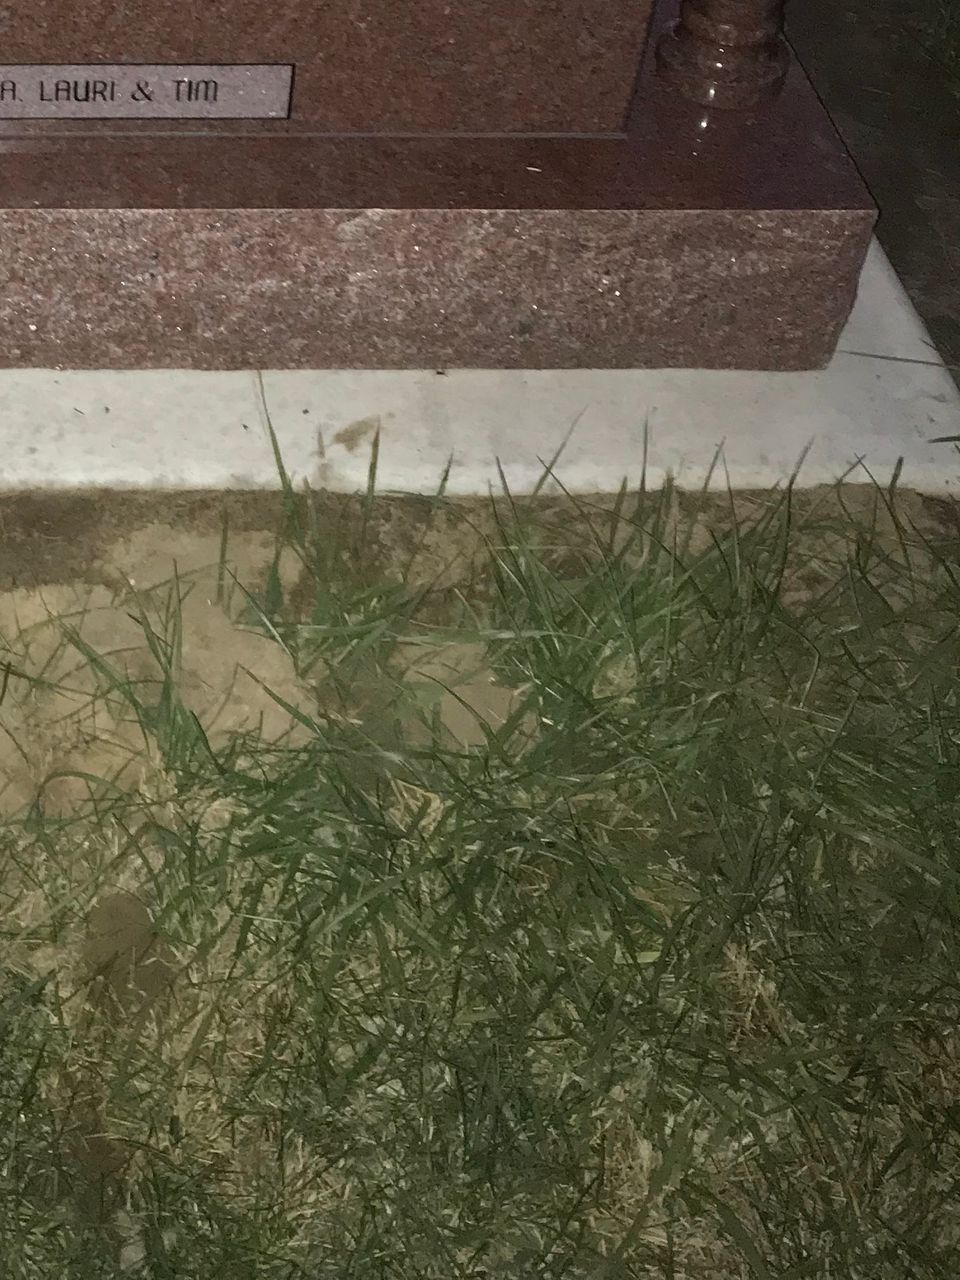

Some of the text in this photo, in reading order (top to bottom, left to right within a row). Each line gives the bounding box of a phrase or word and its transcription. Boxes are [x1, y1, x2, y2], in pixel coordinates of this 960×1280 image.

[40, 80, 115, 102] LAURI
[131, 80, 154, 102] &
[173, 79, 219, 102] TIM
